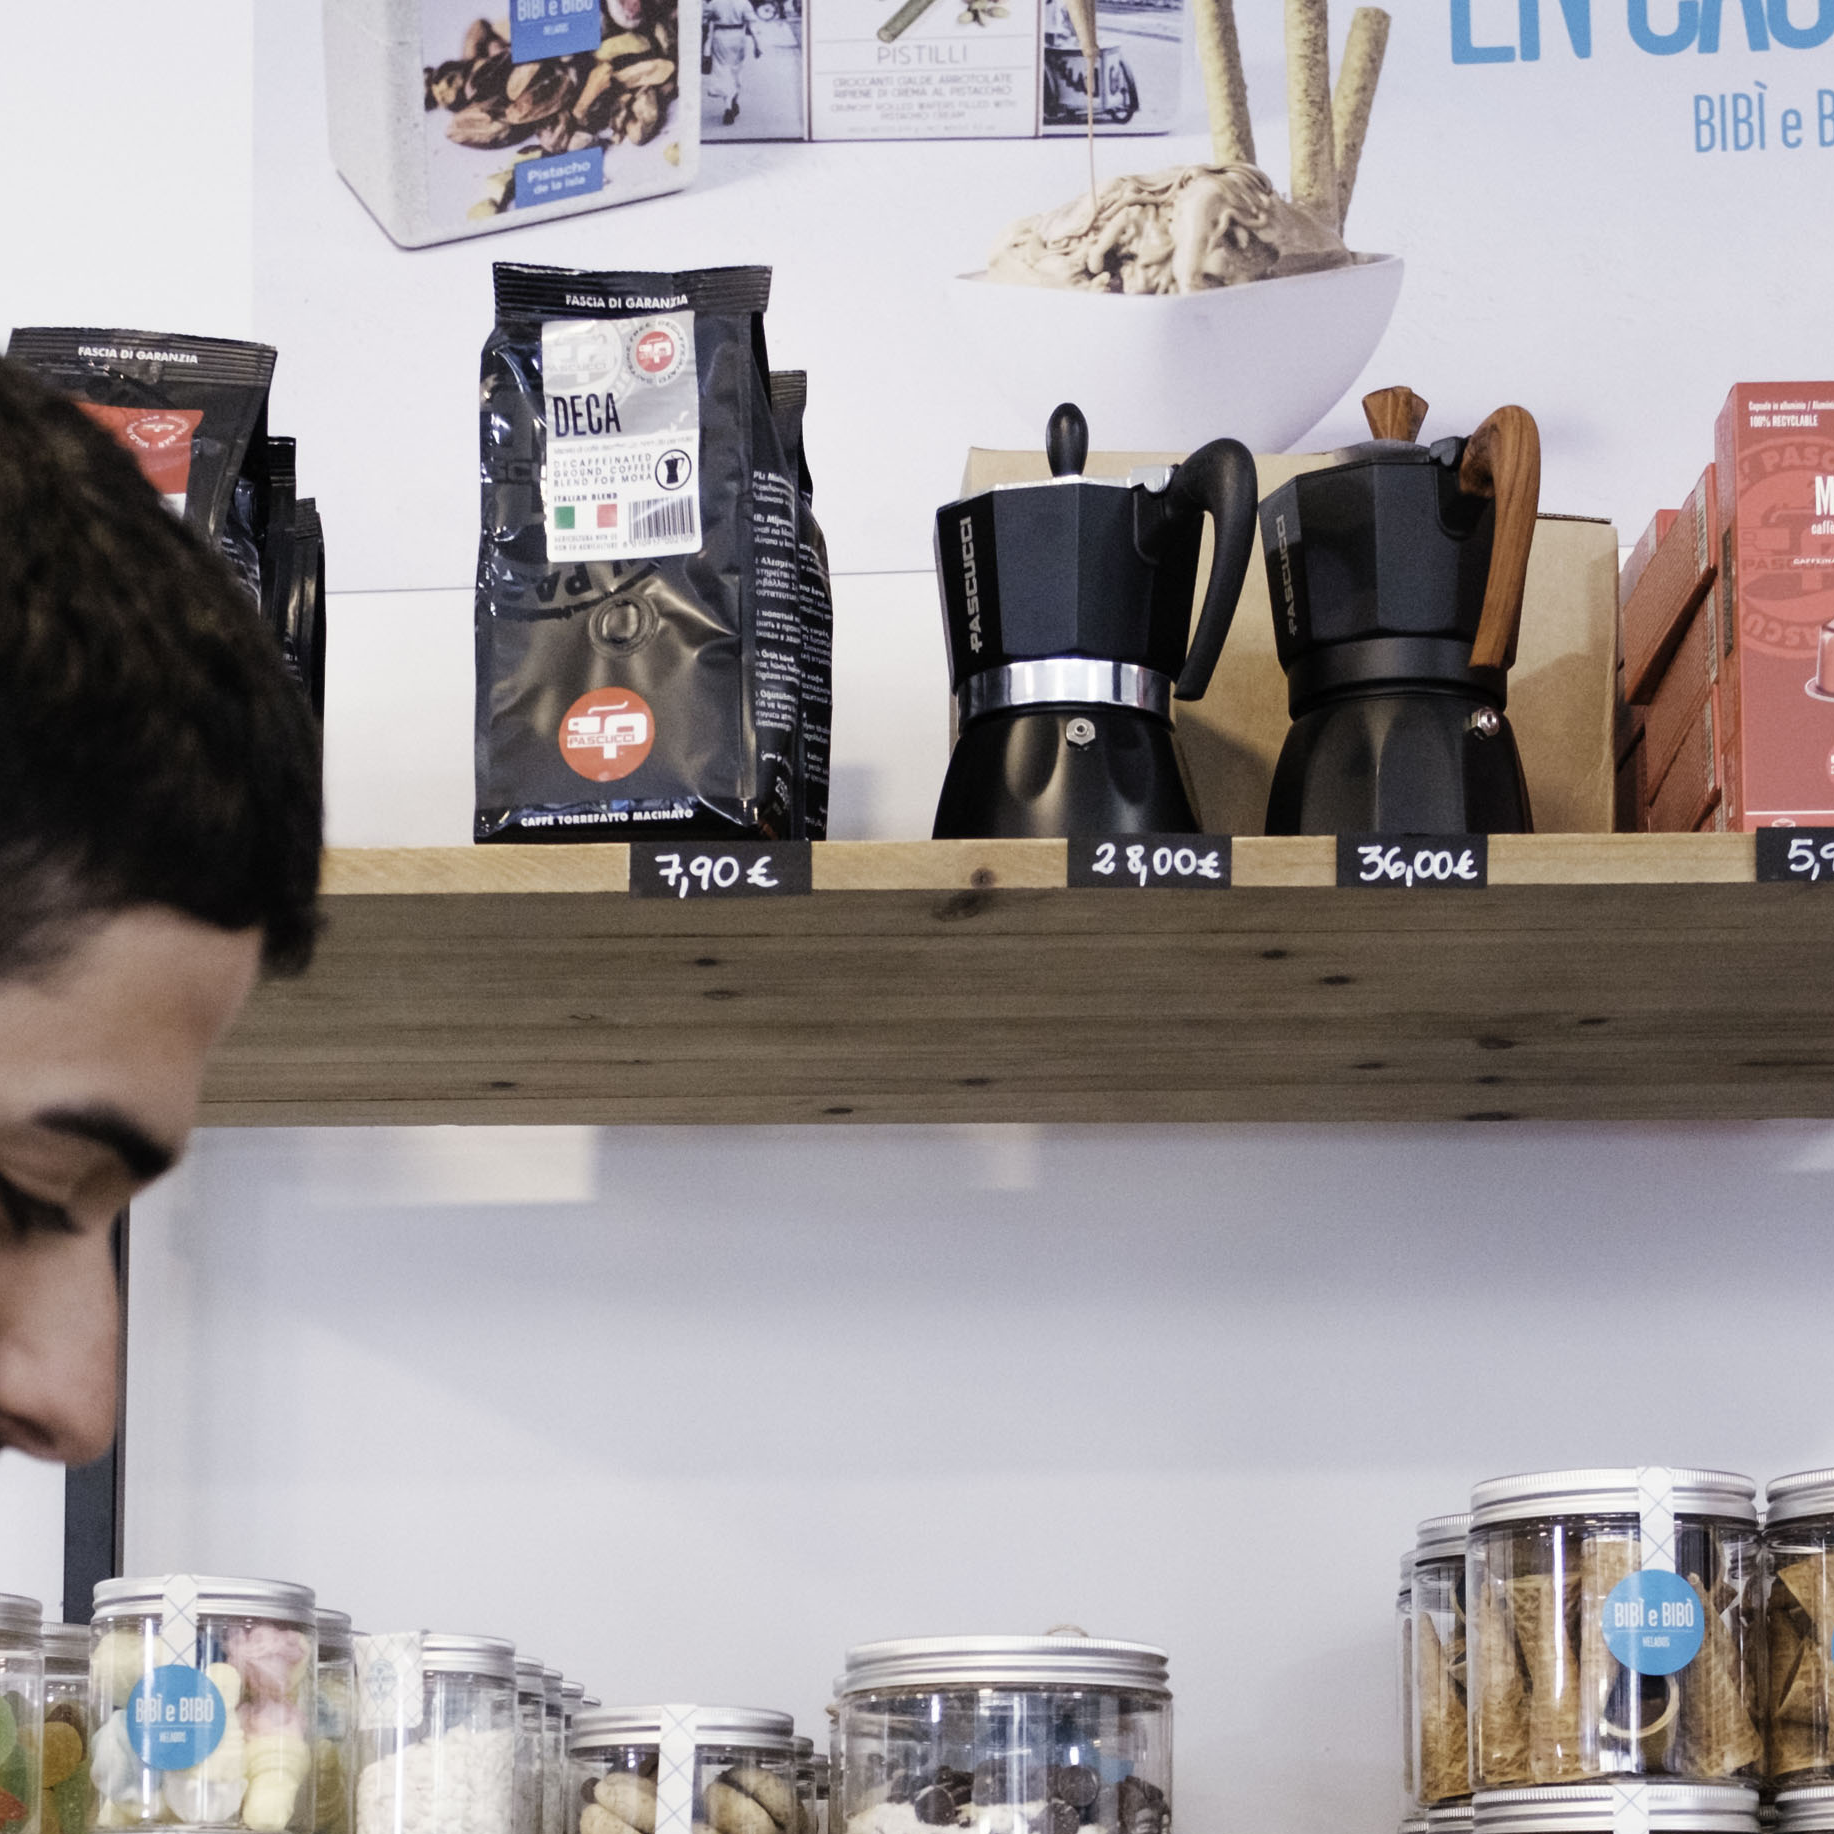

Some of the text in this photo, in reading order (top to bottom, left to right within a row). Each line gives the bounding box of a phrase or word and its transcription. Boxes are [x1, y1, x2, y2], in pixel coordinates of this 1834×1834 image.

[877, 46, 968, 65] PISTILLI
[1694, 80, 1767, 153] BIBÌ
[1781, 108, 1803, 148] e
[527, 161, 591, 183] Pistacho
[565, 294, 689, 309] FASCIA DI GARANZIA
[78, 346, 199, 364] FASCIA DI GARANZIA
[553, 392, 621, 437] DECA
[553, 453, 652, 469] DECAFFEINATED
[554, 462, 652, 479] GROUND COFFEE
[553, 473, 653, 488] BLEND FOR MOKA
[553, 492, 618, 503] ITALIAN BLEND
[1275, 513, 1297, 637] PASCUCCI
[960, 516, 983, 654] PASCUCCI
[568, 734, 636, 745] PASCUCCI
[558, 811, 629, 825] TORREFATTO
[632, 808, 695, 821] MACINATO
[1614, 1598, 1694, 1628] BIBÌ e BIBÒ
[165, 1703, 176, 1723] e
